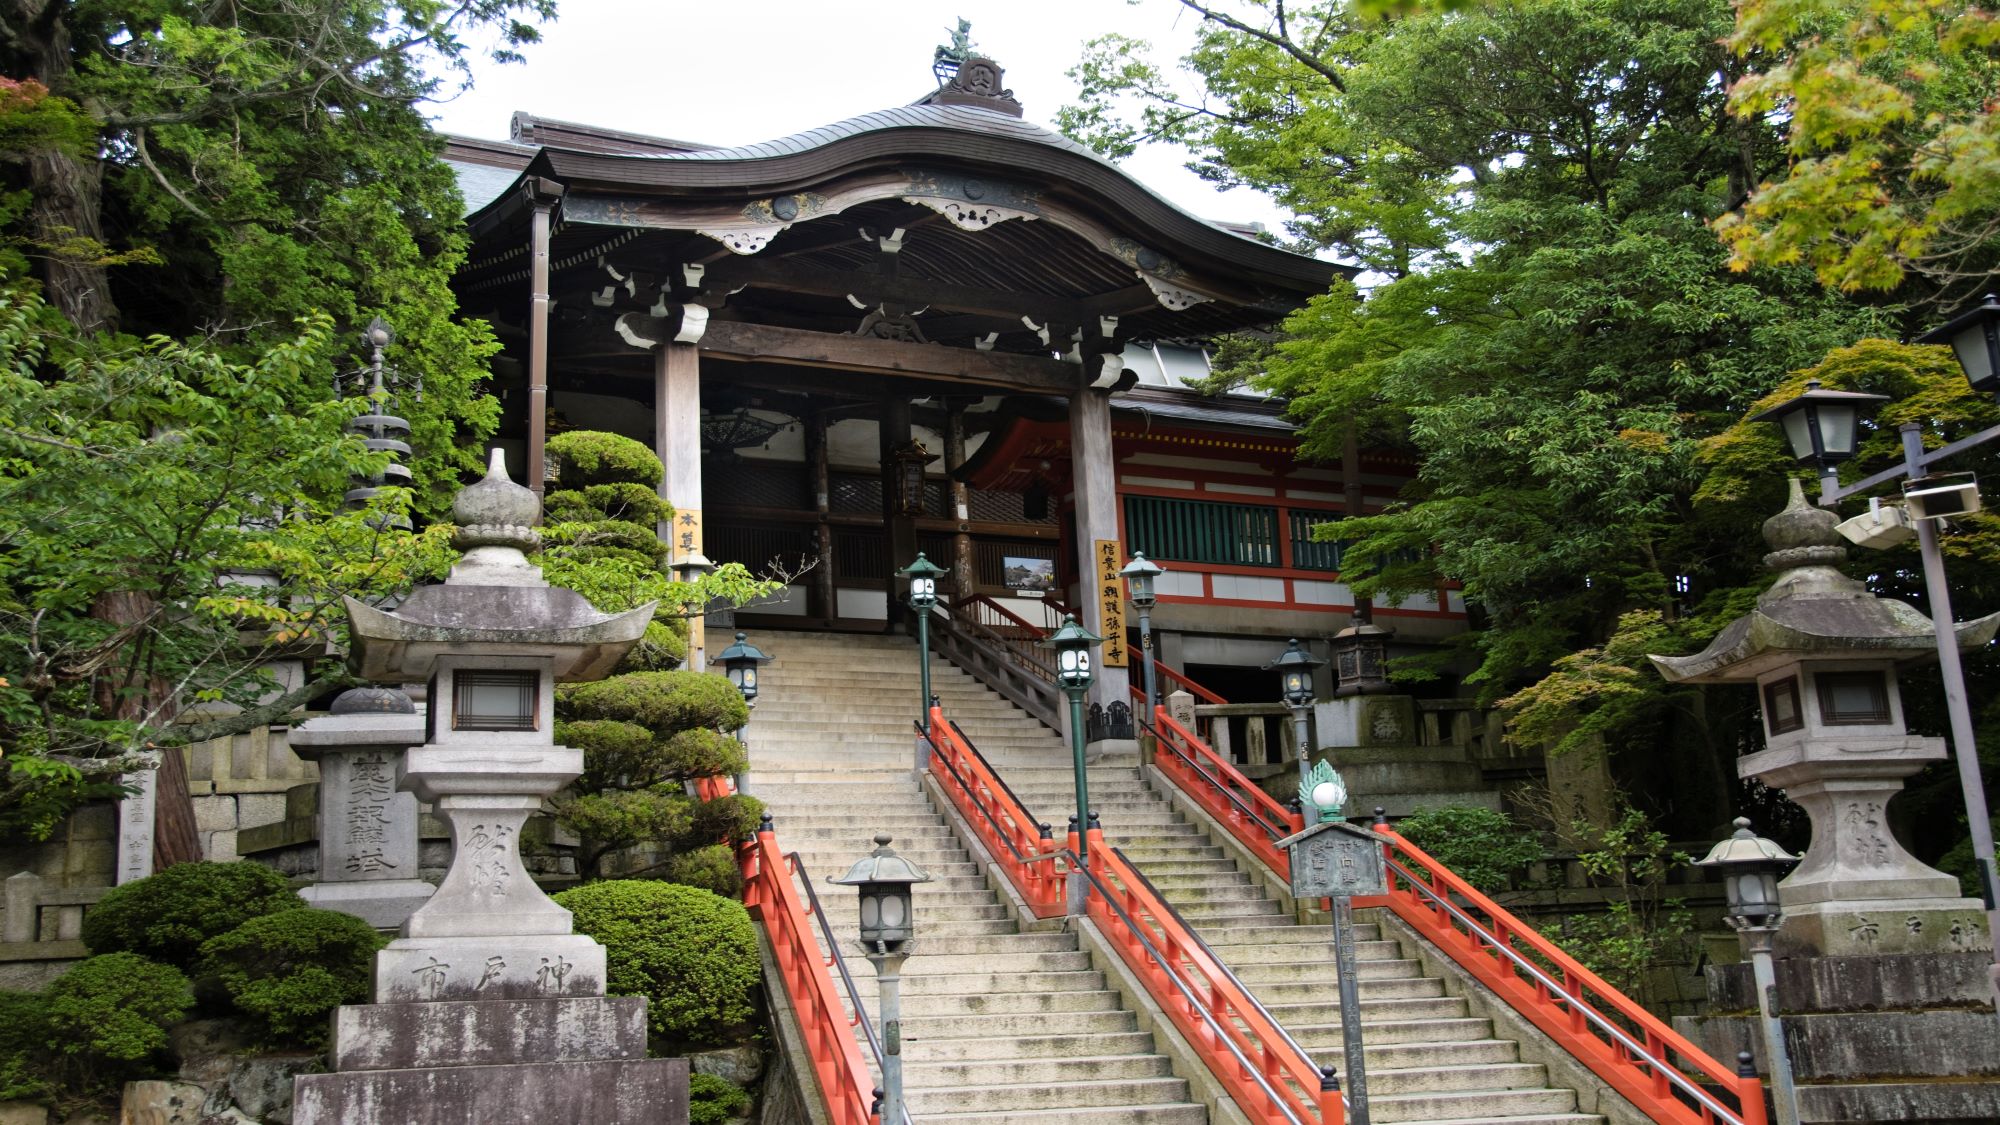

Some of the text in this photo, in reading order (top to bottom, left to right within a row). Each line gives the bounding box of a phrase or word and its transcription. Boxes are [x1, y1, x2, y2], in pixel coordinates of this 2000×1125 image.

[1101, 543, 1122, 664] 信貴山朝護孫子寺
